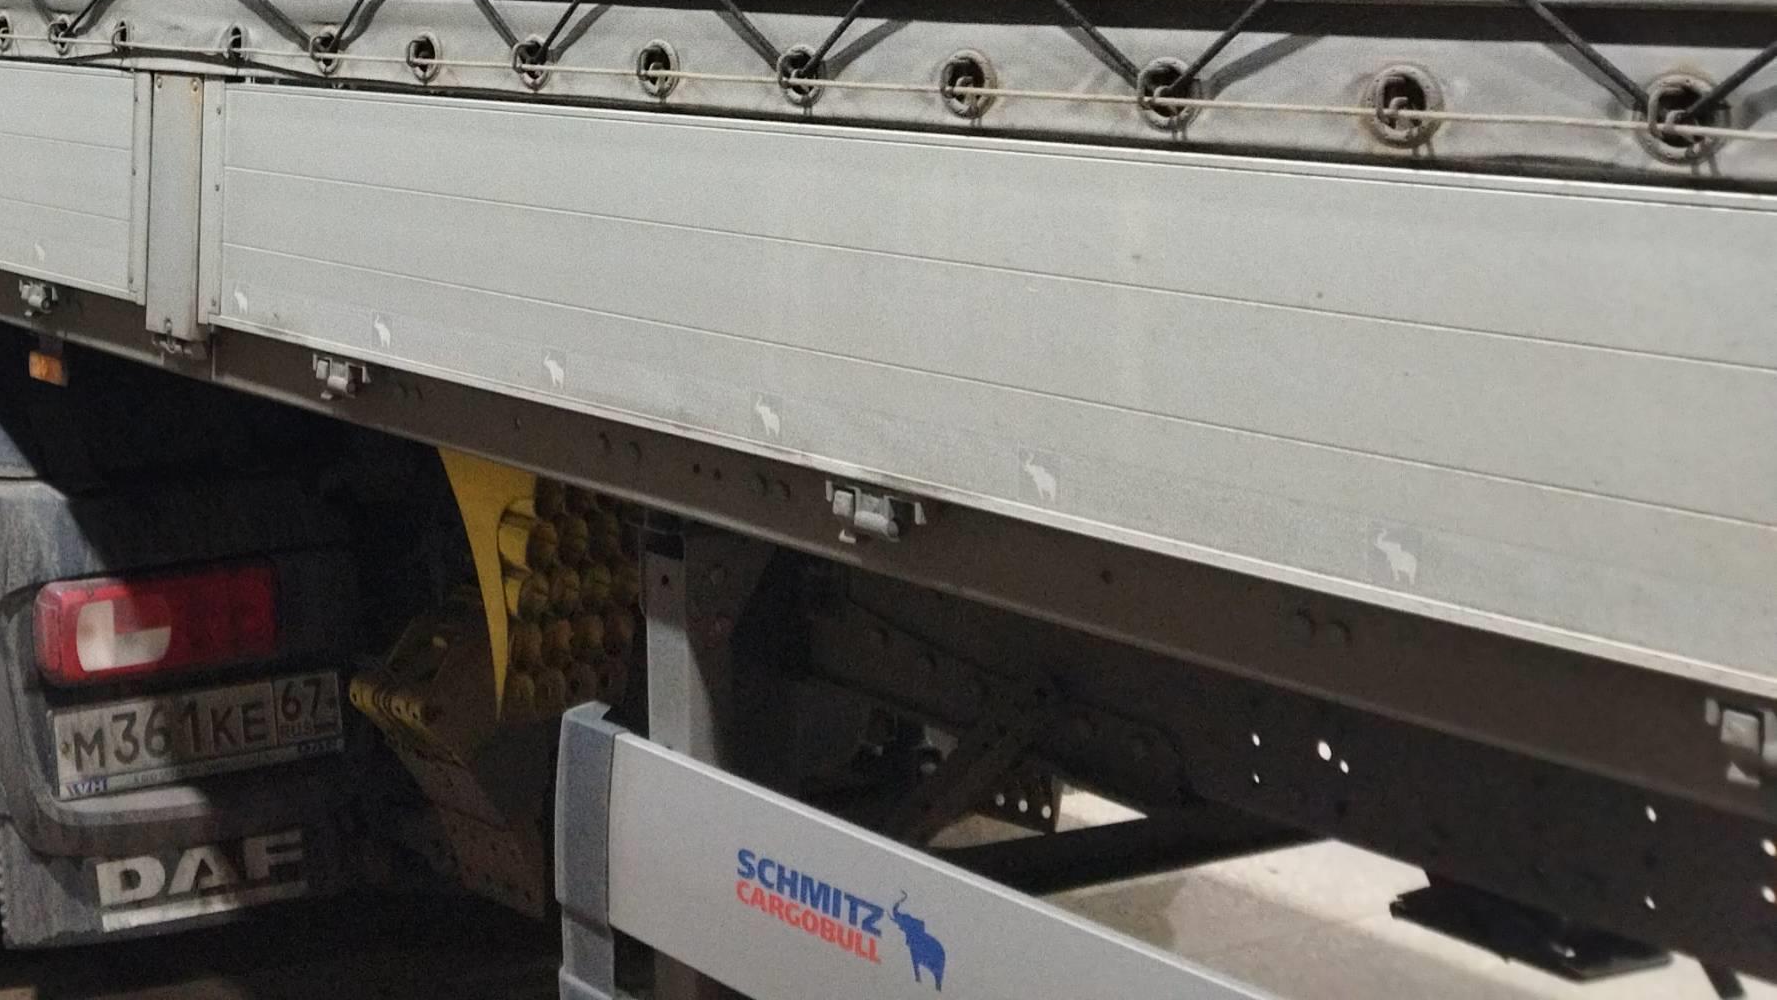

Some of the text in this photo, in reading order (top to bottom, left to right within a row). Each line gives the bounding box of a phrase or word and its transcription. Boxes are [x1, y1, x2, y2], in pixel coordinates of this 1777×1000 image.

[73, 701, 265, 772] М361КЕ
[281, 679, 321, 721] 67
[96, 829, 303, 906] DAF
[737, 848, 884, 937] SCHMITZ
[736, 879, 882, 965] CARGOBULL
